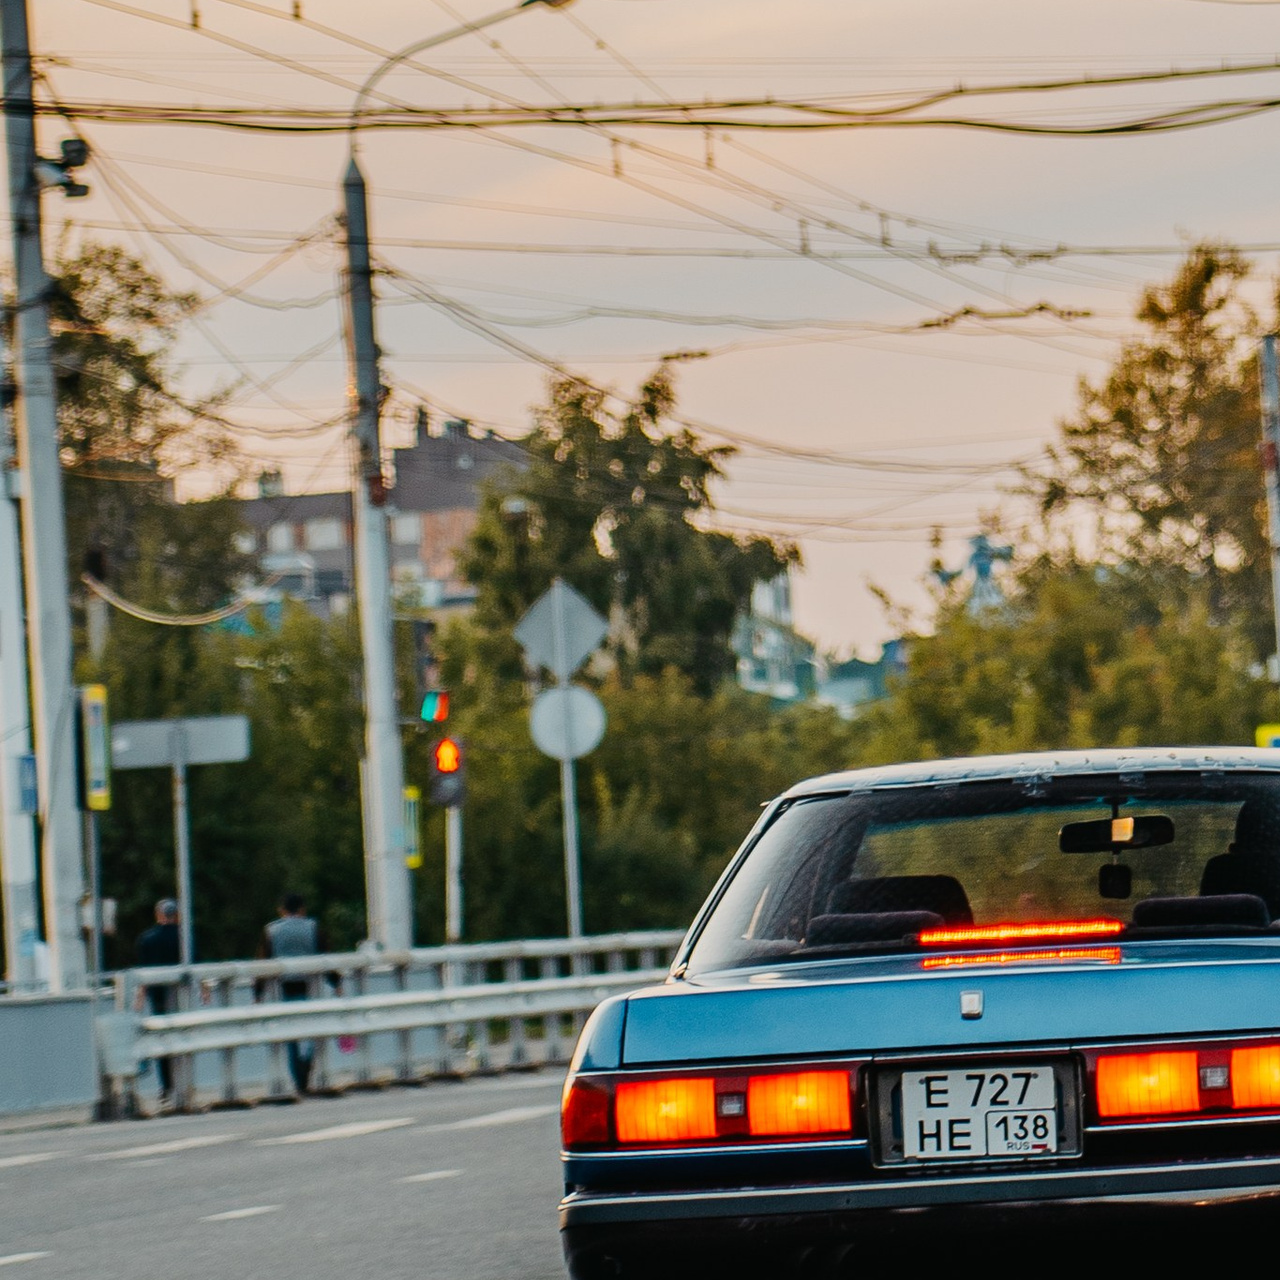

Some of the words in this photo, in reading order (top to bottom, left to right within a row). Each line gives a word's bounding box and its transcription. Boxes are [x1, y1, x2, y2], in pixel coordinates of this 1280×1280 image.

[965, 1072, 1032, 1107] 727
[995, 1114, 1049, 1142] 138
[1006, 1141, 1030, 1151] RUS
